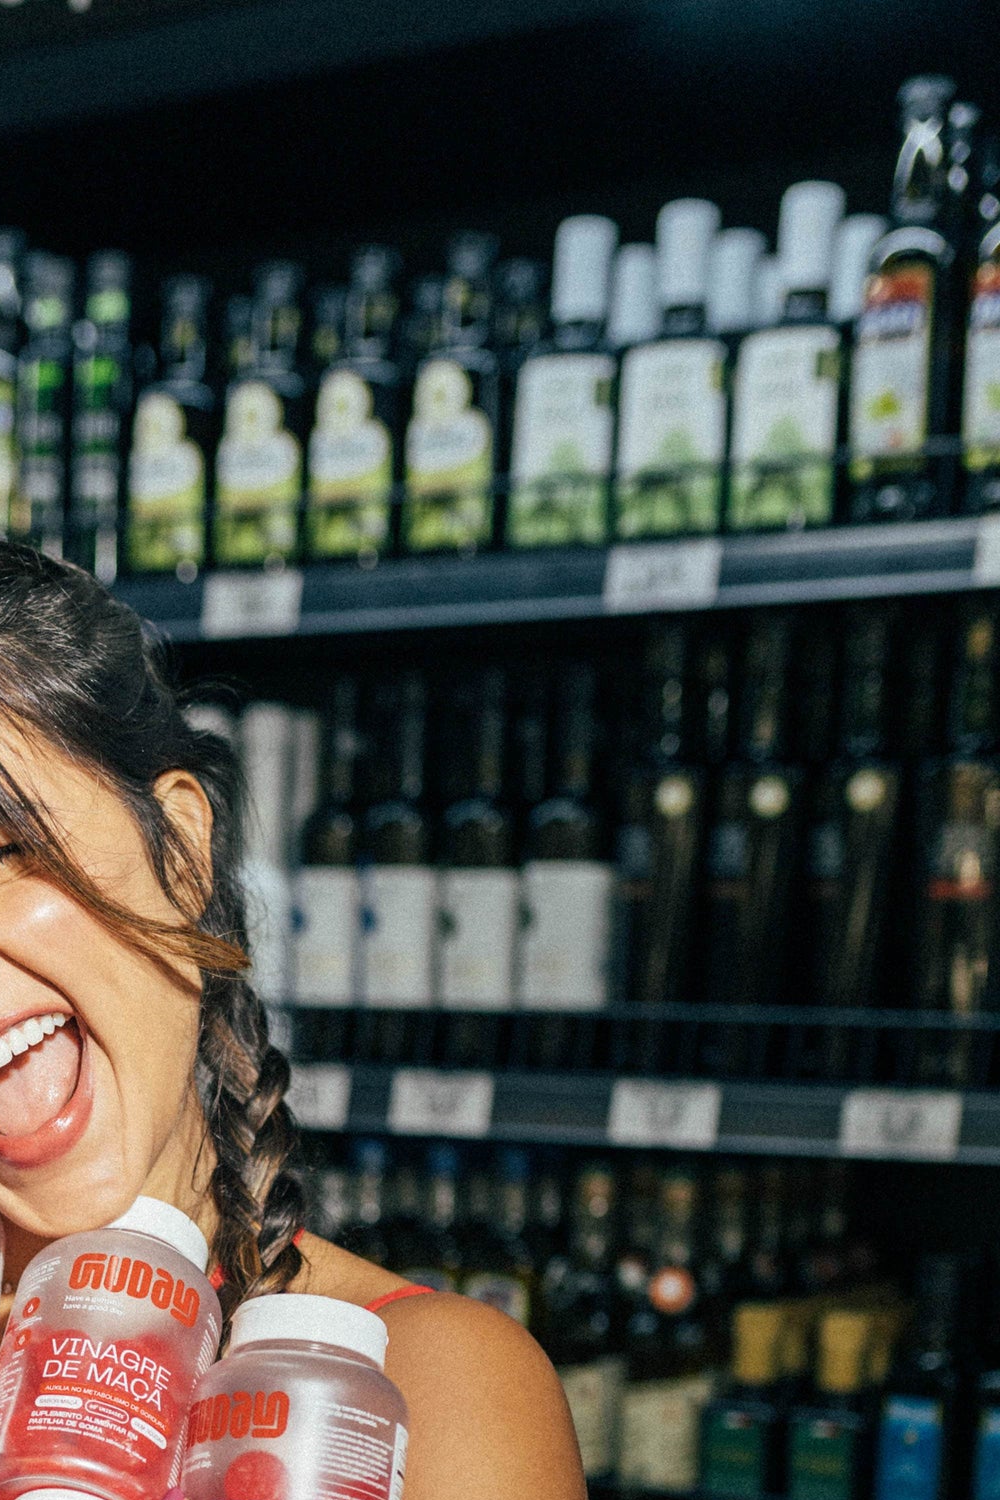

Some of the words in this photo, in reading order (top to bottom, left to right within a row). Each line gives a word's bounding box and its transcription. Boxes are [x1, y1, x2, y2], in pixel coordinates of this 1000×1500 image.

[42, 1359, 81, 1378] DE
[87, 1362, 168, 1411] MAÇÃ
[51, 1338, 171, 1385] VINAGRE
